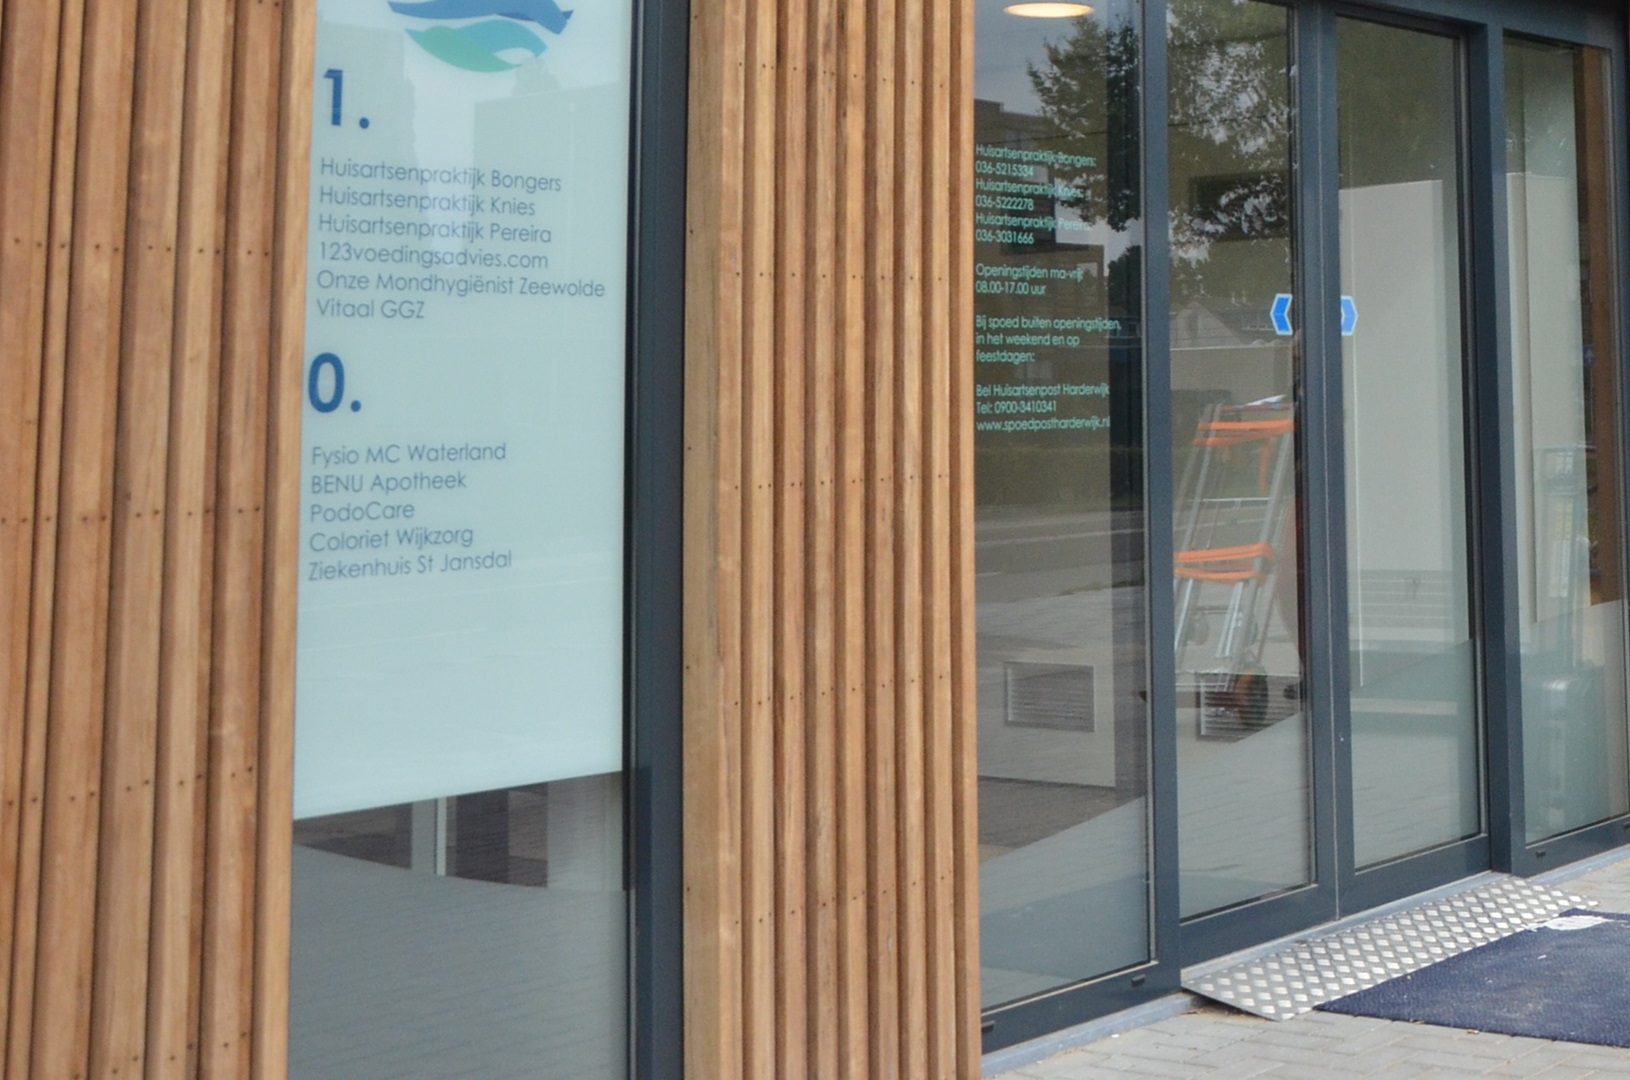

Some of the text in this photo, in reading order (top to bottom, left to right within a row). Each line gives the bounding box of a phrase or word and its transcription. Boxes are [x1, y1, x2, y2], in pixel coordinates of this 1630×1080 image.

[323, 68, 370, 130] 1.
[976, 144, 1057, 165] Huisartsenpraktijk
[320, 157, 562, 194] Huisartsenpraktijk Bongers
[976, 178, 1056, 198] Huisartsenpraktijk
[319, 185, 536, 217] Huisartsenpraktijk Knies
[319, 213, 552, 243] Huisartsenpraktijk Pereira
[976, 212, 1056, 231] Huisartsenpraktijk
[321, 241, 549, 269] 123voedingsadvies.com
[317, 269, 606, 298] Onze Mondhygiënist Zeewolde
[975, 263, 1048, 280] Openingstijden
[1030, 284, 1047, 295] uur
[316, 298, 425, 319] Vitaal GGZ
[975, 315, 987, 330] Bij
[988, 316, 1019, 331] spoed
[1021, 316, 1051, 329] buiten
[975, 332, 1080, 349] in het weekend en op
[308, 352, 362, 414] 0.
[975, 382, 1110, 398] Bel Huisartsenpost Harderwijk
[312, 442, 506, 469] Fysio MC Waterland
[311, 470, 467, 495] BENU Apotheek
[310, 501, 415, 523] PodoCare
[309, 526, 474, 553] Coloriet Wijkzorg
[308, 550, 512, 582] Ziekenhuis St Jansdal
